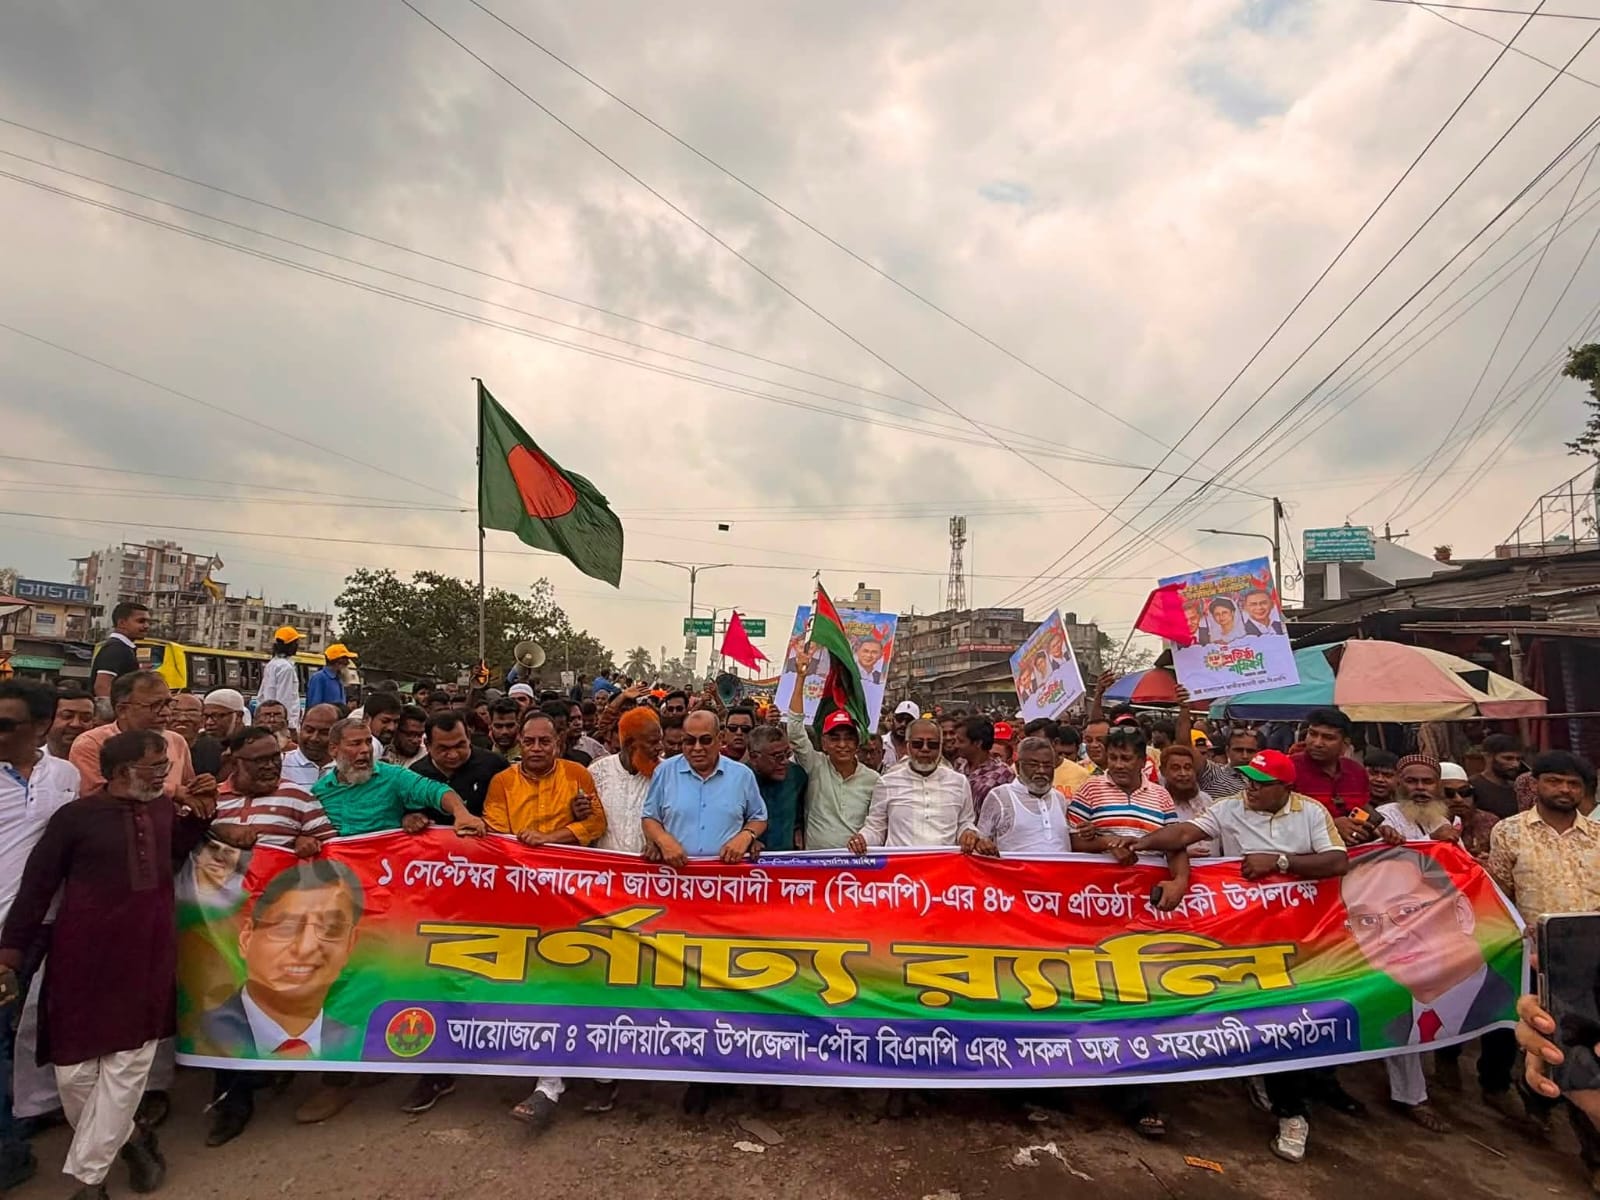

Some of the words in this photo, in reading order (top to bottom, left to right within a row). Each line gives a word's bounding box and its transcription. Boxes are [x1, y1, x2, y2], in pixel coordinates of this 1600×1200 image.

[378, 859, 392, 886] ১
[404, 852, 498, 890] সেপ্টেম্বর
[504, 863, 615, 897] বাংলাদেশ
[622, 867, 773, 903] জাতীয়তাবাদী
[778, 877, 816, 905] দল
[825, 872, 976, 916] (বিএনপি)-এর
[983, 887, 1015, 912] ৪৮
[1023, 889, 1062, 916] তম
[1068, 883, 1135, 919] প্রতিষ্ঠা
[1222, 880, 1319, 911] উপলক্ষে
[418, 905, 869, 1007] বর্ণাঢ্য
[447, 1017, 560, 1054] আয়োজনে
[586, 1014, 709, 1057] কালিয়াকৈর
[713, 1018, 870, 1064] উপজেলা-পৌর
[876, 1025, 959, 1067] বিএনপি
[964, 1037, 1013, 1069] এবং
[1014, 1036, 1073, 1067] সকল
[1076, 1034, 1120, 1066] অঙ্গ
[1128, 1034, 1151, 1060] ও
[1156, 1018, 1252, 1062] সহযোগী
[1256, 1008, 1337, 1053] সংগঠন
